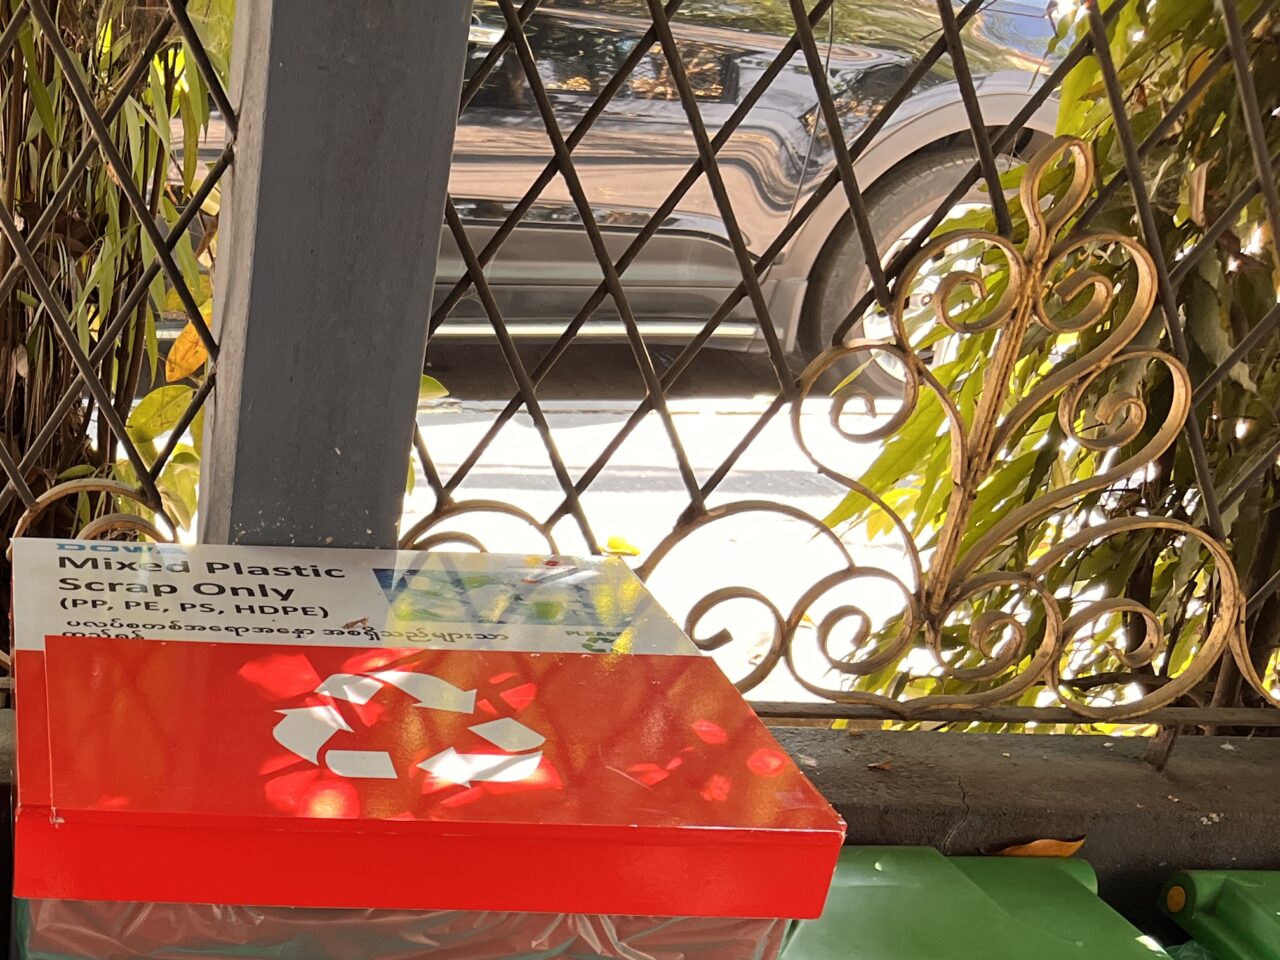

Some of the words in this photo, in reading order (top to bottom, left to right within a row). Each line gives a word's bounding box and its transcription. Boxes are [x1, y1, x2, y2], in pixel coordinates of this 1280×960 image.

[58, 556, 190, 573] Mixed
[206, 561, 346, 578] Plastic
[58, 578, 178, 597] Scrap
[193, 582, 295, 601] Only
[60, 598, 113, 611] (PP,
[125, 600, 169, 613] PE,
[180, 602, 225, 615] PS,
[235, 605, 329, 619] HDPE)
